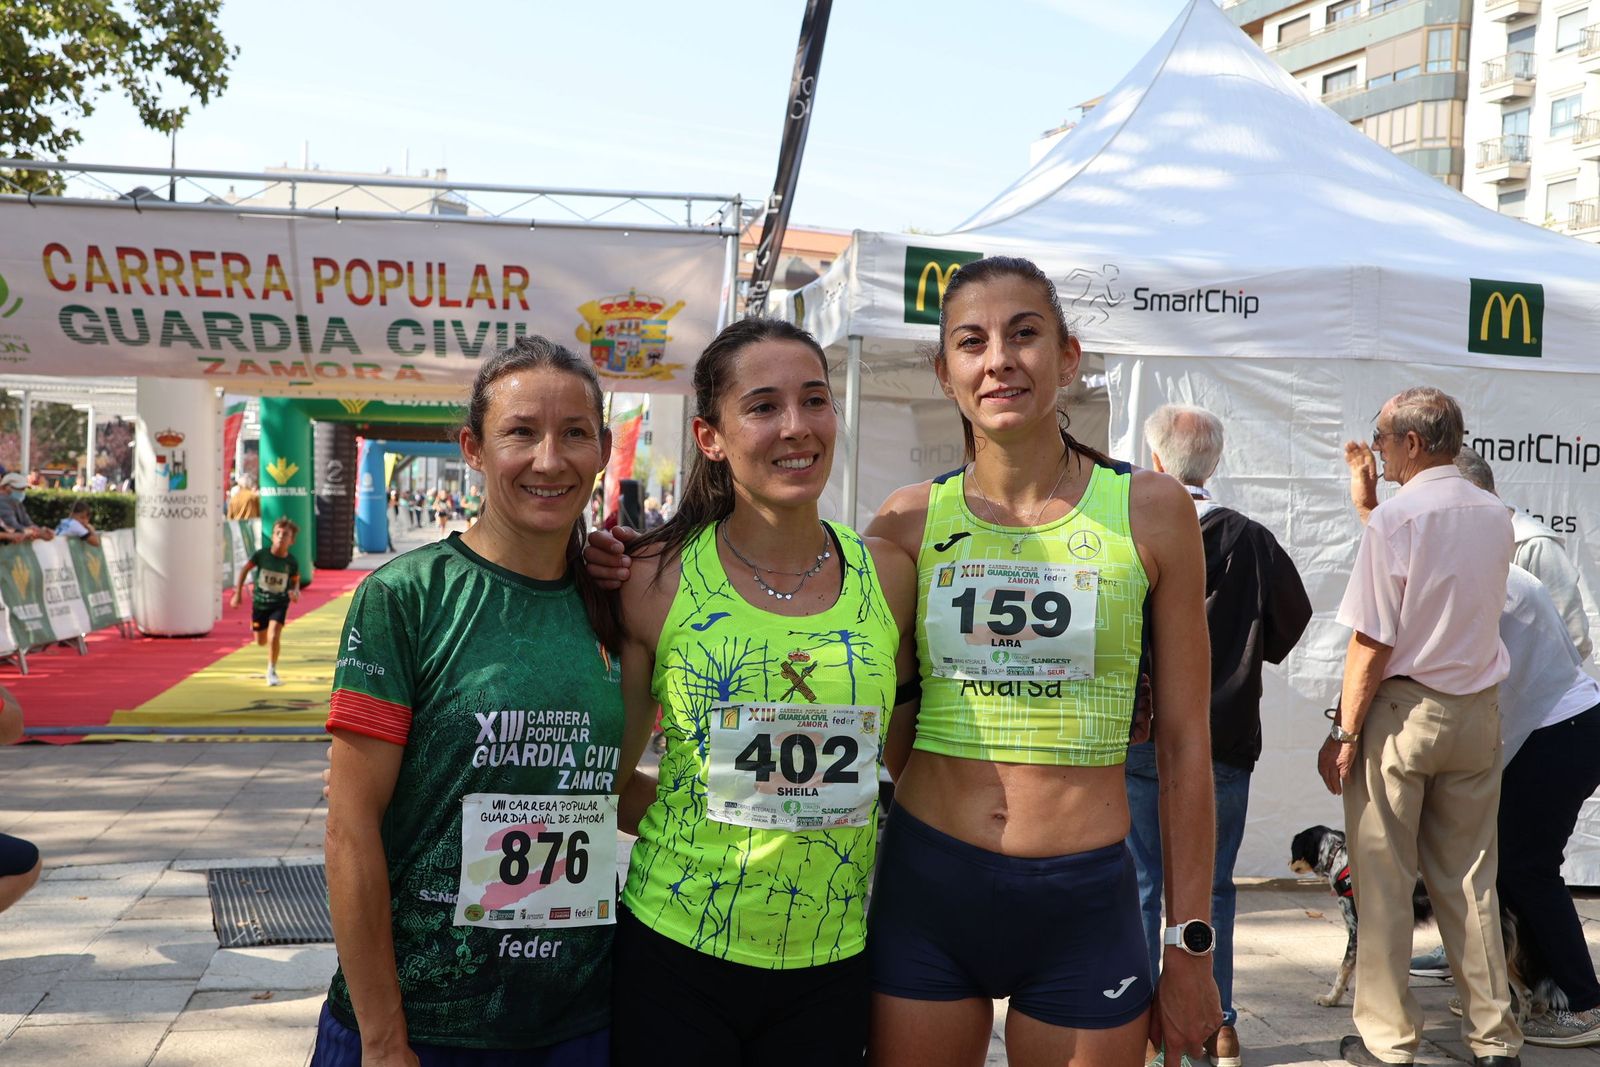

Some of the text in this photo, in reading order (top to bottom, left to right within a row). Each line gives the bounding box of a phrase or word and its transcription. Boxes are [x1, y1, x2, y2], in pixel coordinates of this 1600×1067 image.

[42, 242, 530, 311] CARRERA POPULAR
[1133, 287, 1259, 319] SmartChip
[58, 304, 363, 356] GUARDIA
[198, 357, 425, 382] ZAMORA
[1463, 430, 1600, 473] martChip
[151, 506, 208, 520] ZAMORA
[961, 564, 985, 578] XIII
[987, 569, 1039, 579] GUARDIA CIVIL
[1043, 573, 1067, 582] feder
[1007, 577, 1040, 585] ZAMORA
[952, 587, 1072, 638] 159
[991, 638, 1022, 648] LARA
[527, 710, 591, 726] CARRERA
[748, 707, 776, 723] XIII
[832, 716, 855, 725] feder
[475, 710, 525, 744] XIII
[525, 727, 590, 743] POPULAR
[472, 743, 620, 770] GUARDIA CIVI
[735, 733, 859, 784] 402
[777, 787, 819, 797] SHEILA
[509, 800, 557, 811] CARRERA
[561, 801, 598, 811] POPULAR
[480, 812, 527, 823] GUARDiA
[558, 814, 570, 822] DE
[499, 830, 590, 886] 876
[498, 934, 562, 959] feder
